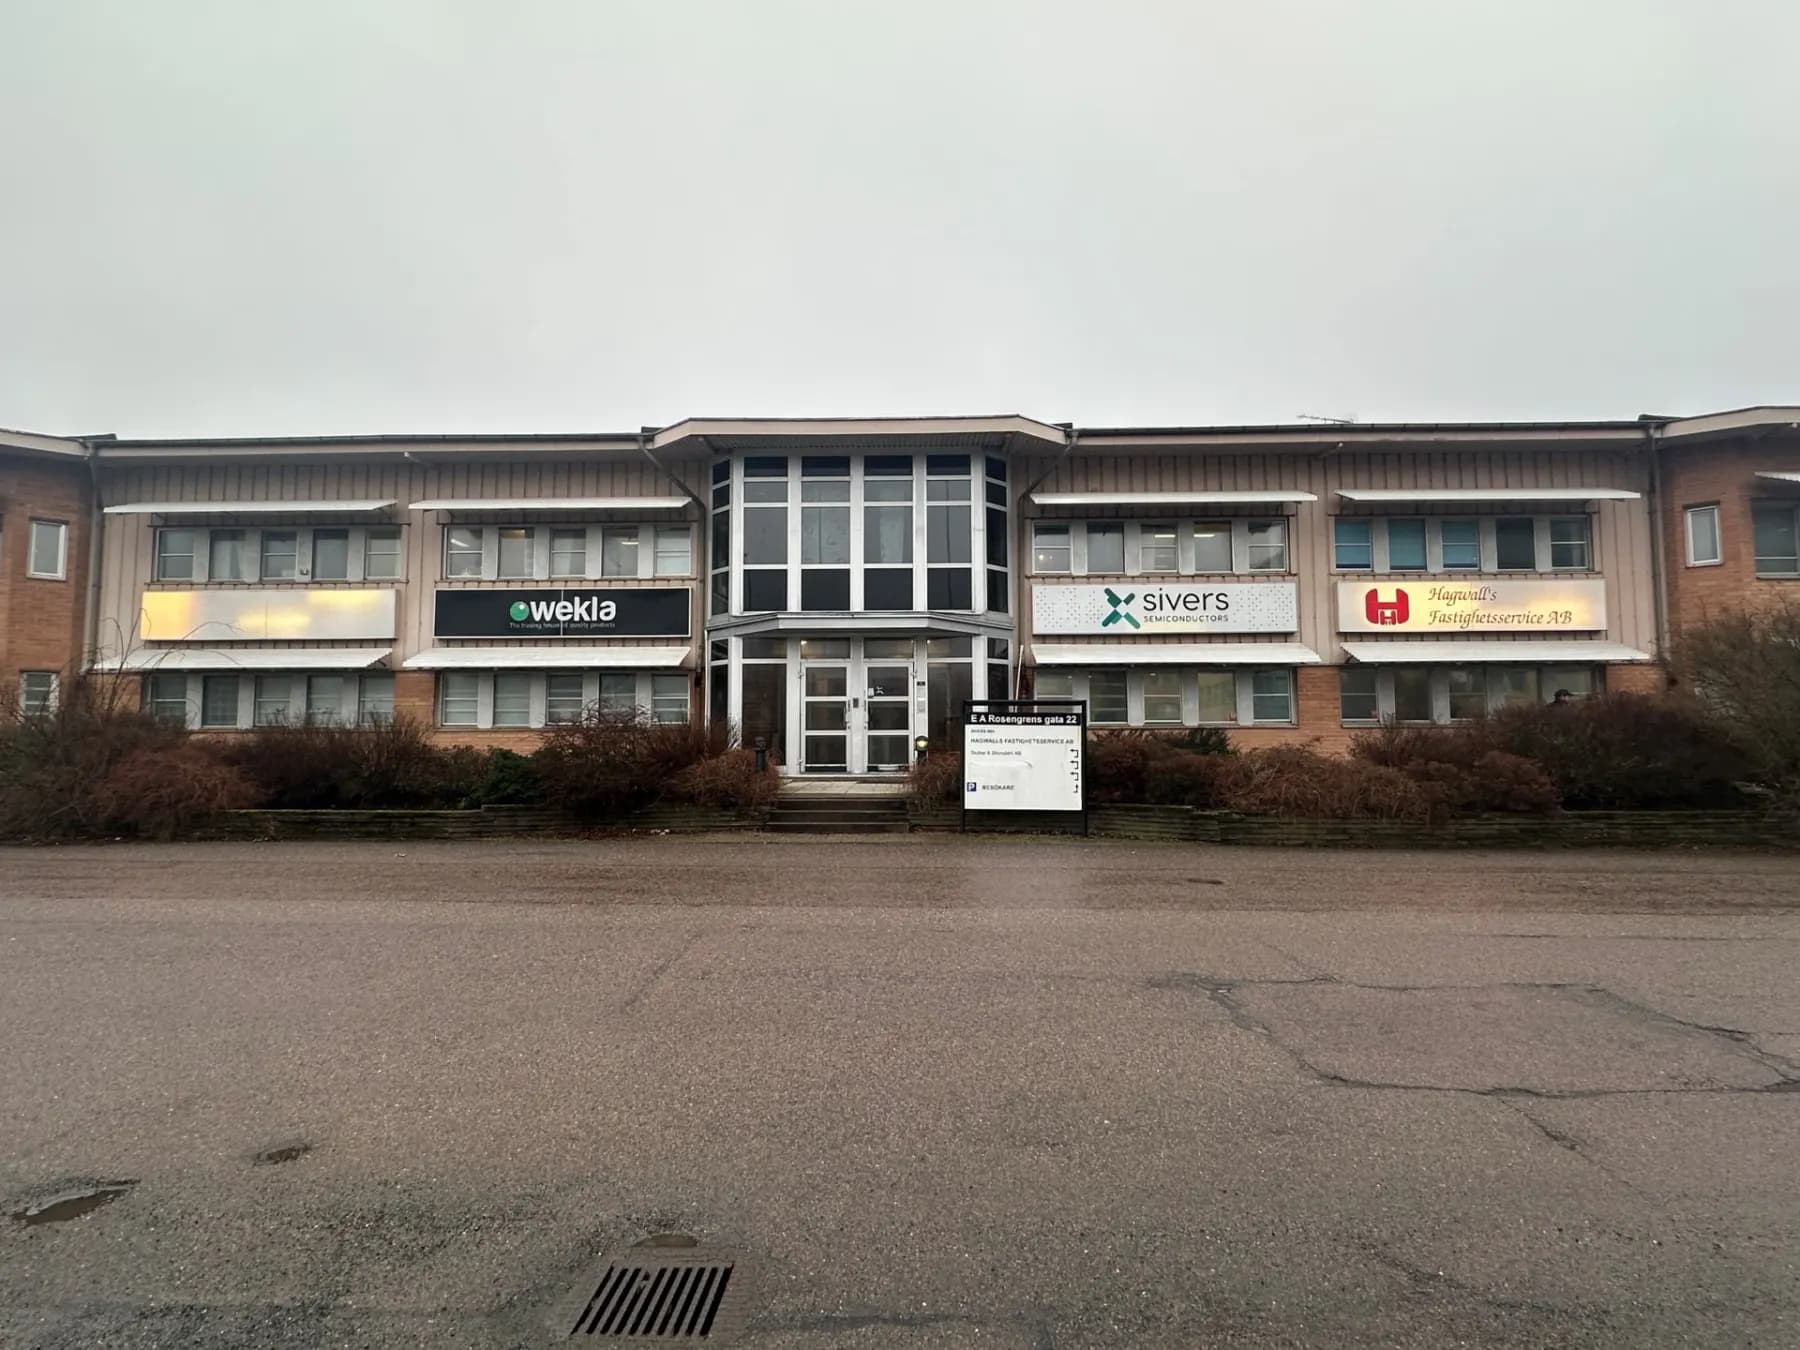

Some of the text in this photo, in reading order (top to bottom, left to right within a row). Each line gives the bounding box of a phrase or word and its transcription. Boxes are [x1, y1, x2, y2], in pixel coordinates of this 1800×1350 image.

[1143, 587, 1229, 611] sivers
[1428, 586, 1497, 606] Hagwall's
[530, 596, 616, 621] wekla
[1428, 609, 1572, 629] Fastighetsservice AB
[971, 714, 1078, 725] E A Rosengrens gata 22
